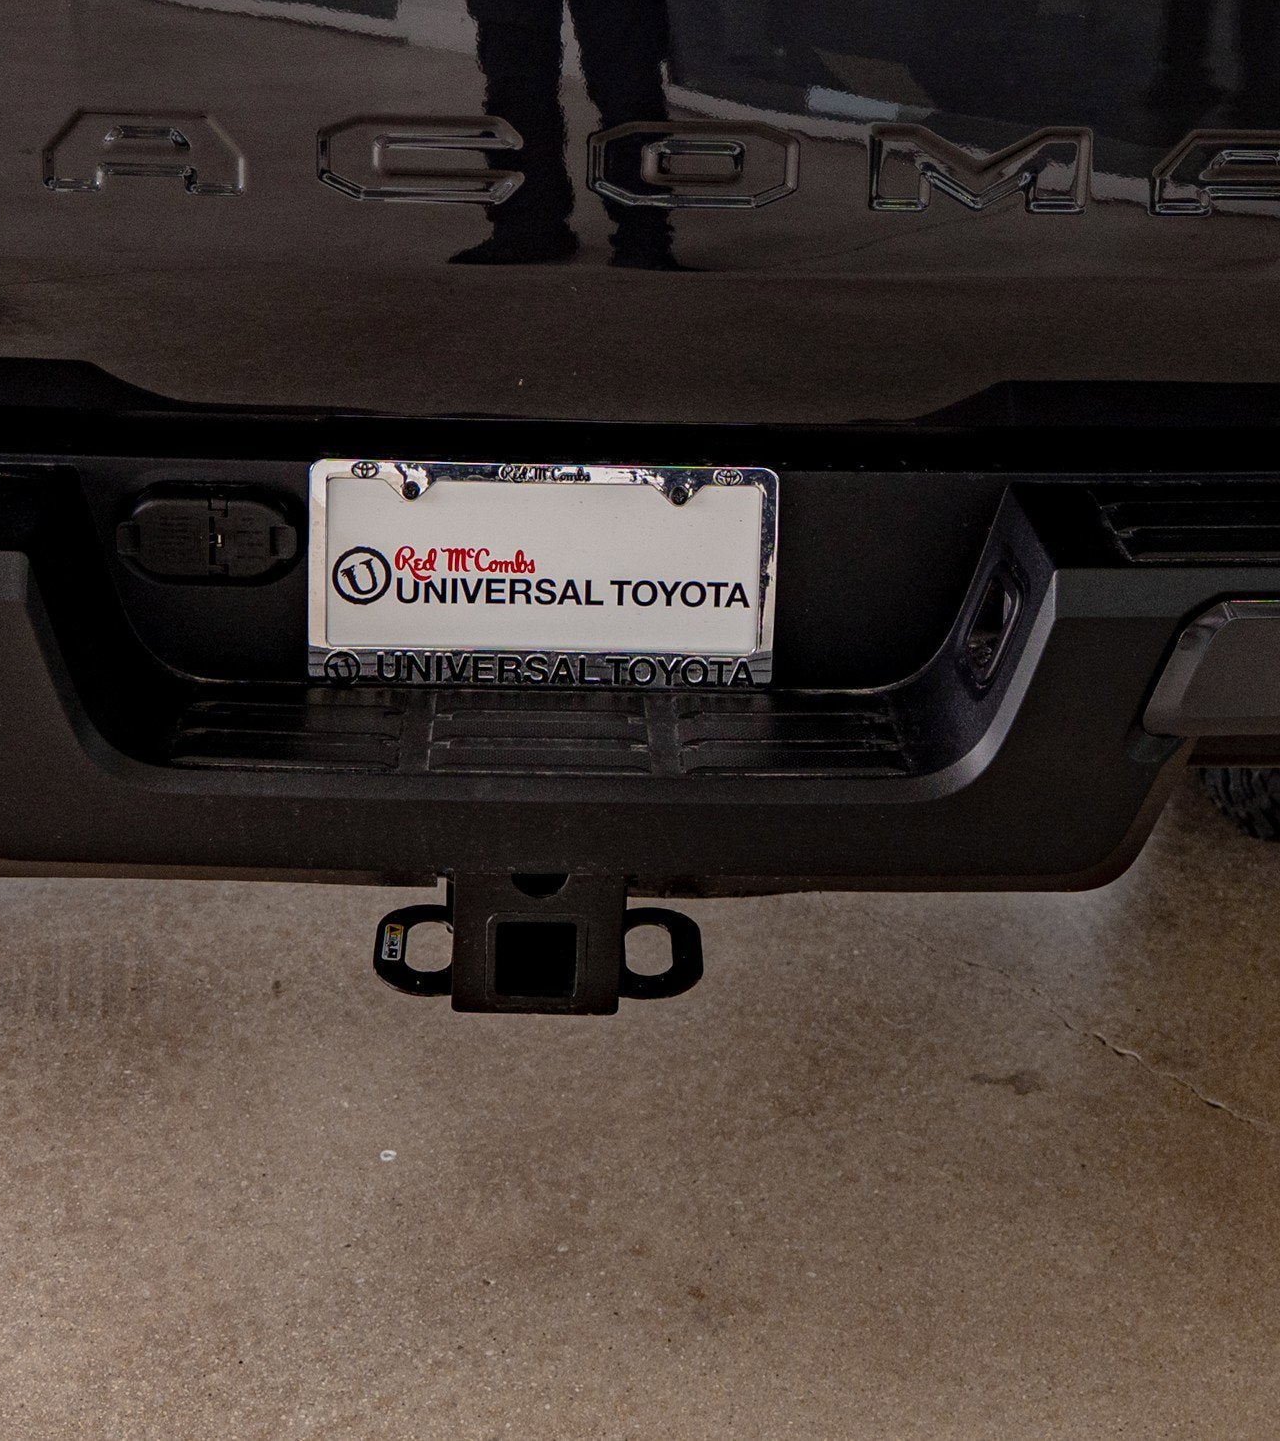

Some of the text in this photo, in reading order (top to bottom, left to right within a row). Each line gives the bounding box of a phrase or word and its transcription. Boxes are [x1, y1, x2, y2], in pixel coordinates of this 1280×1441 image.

[499, 463, 592, 483] Red McCombs
[395, 546, 536, 581] Red McCombs
[396, 576, 751, 608] UNIVERSAL TOYOTA
[376, 651, 602, 684] UNIVERSAL
[606, 655, 755, 688] TOYOTA
